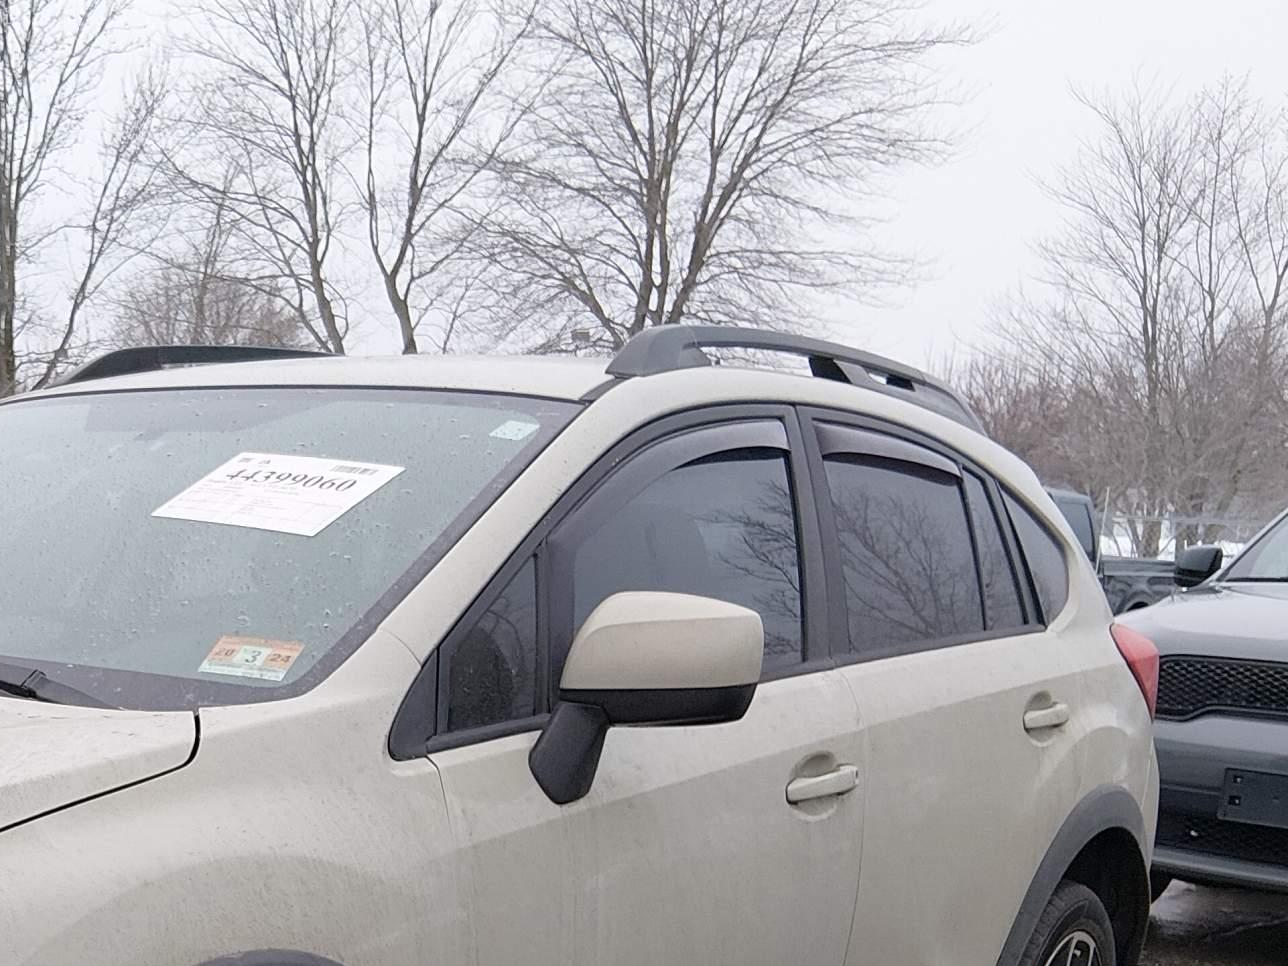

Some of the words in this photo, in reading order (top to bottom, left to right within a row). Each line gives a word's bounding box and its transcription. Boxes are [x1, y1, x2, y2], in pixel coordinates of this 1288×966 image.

[226, 468, 358, 492] 44399060
[214, 647, 235, 657] 20
[244, 649, 262, 664] 3
[269, 653, 292, 664] 24
